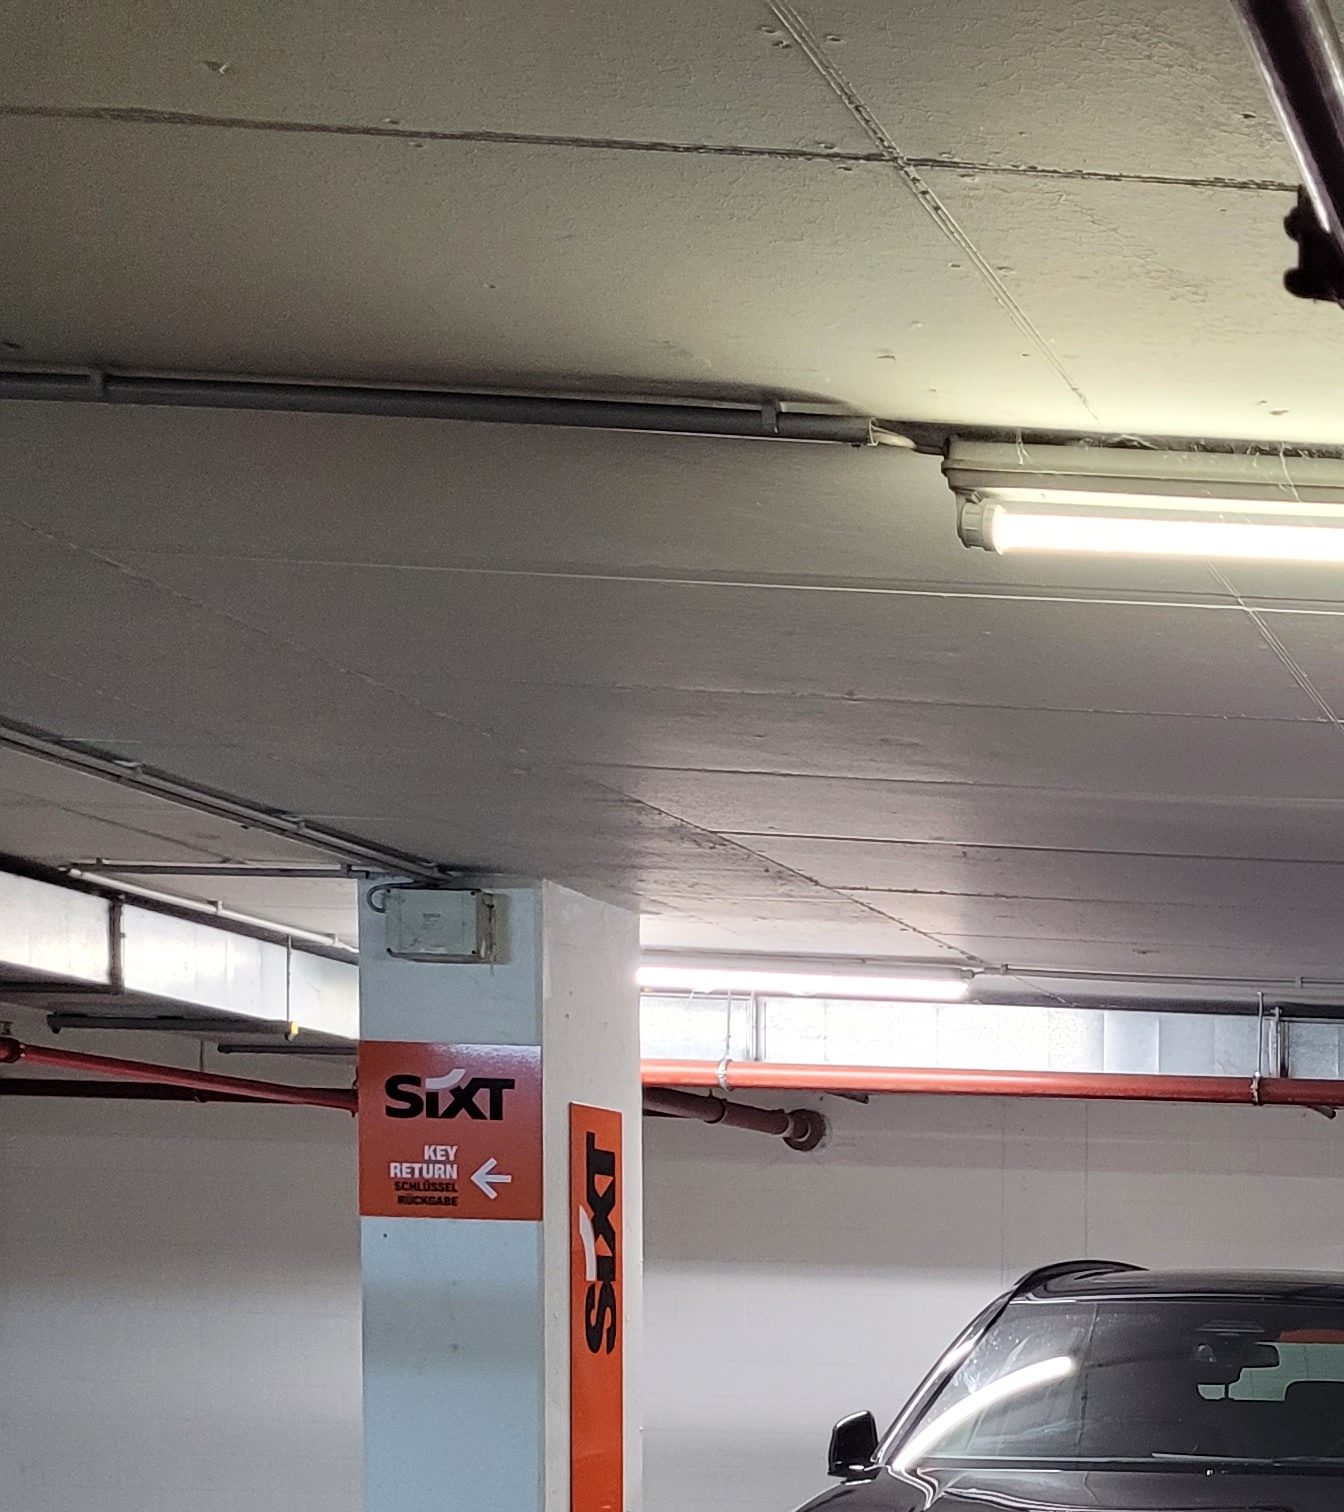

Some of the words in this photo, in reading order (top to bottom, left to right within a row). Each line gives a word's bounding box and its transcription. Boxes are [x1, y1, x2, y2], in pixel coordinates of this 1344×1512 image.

[423, 1145, 458, 1161] KEY
[389, 1162, 458, 1179] RETURN
[394, 1180, 458, 1193] SCHLÜSSEL
[397, 1194, 459, 1207] RÜCKGABE
